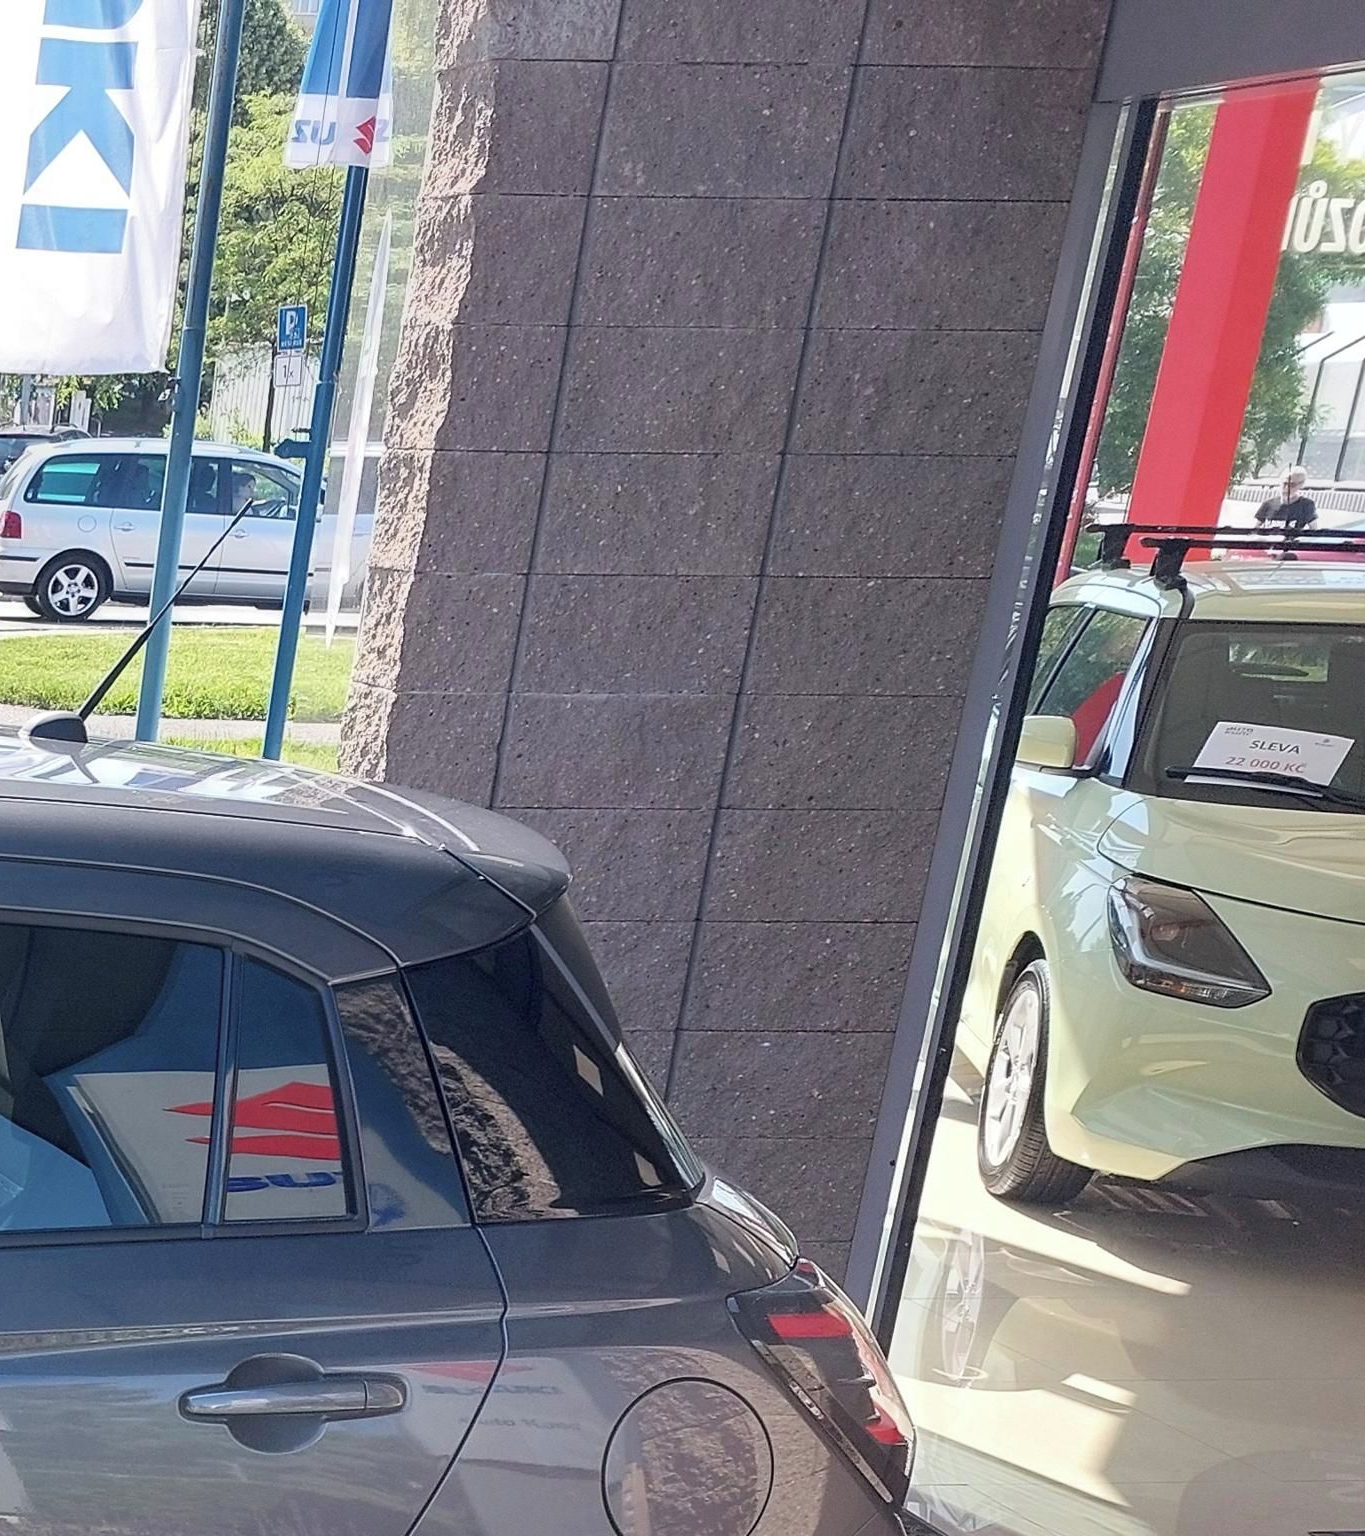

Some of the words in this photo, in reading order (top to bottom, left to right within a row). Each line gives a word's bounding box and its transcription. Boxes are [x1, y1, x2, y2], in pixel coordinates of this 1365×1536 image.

[1249, 740, 1301, 755] SLEVA
[1225, 756, 1246, 767] 22
[1249, 758, 1281, 771] 000
